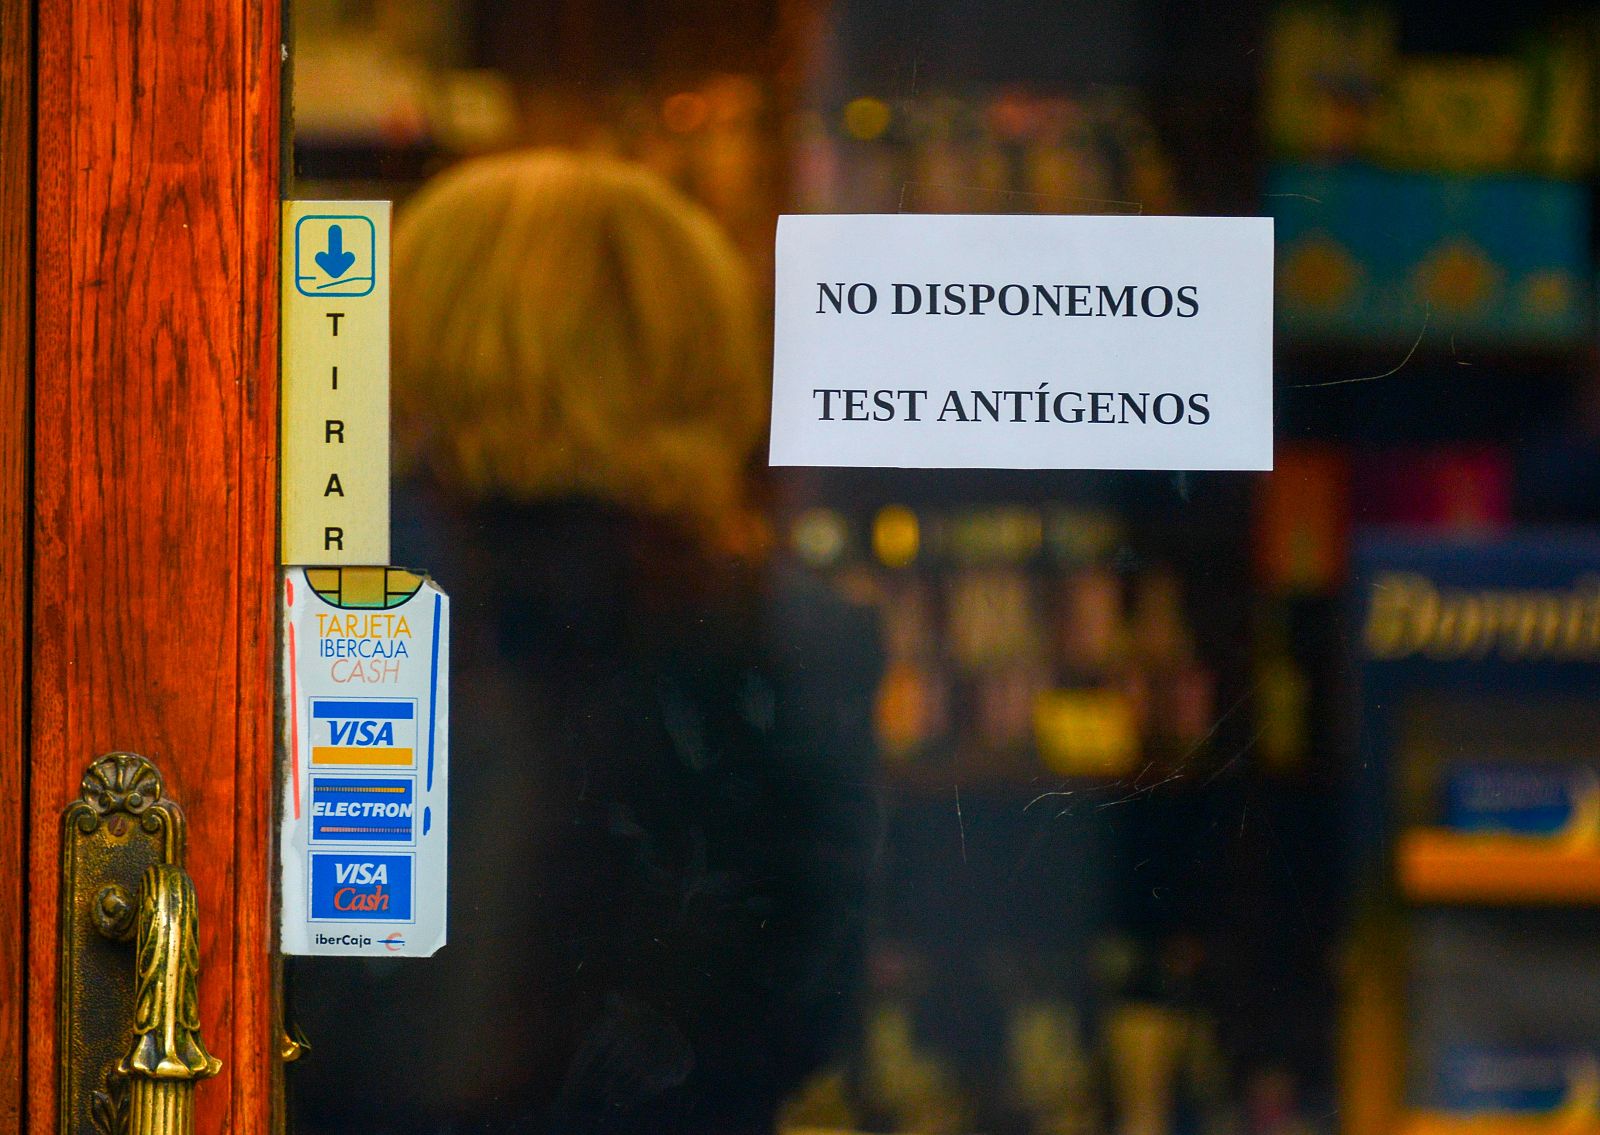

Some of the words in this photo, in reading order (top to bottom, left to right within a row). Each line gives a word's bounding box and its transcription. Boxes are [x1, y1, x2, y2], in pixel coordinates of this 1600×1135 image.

[815, 282, 878, 315] NO
[891, 283, 1200, 318] DISPONEMOS
[813, 388, 928, 422] TEST
[936, 382, 1211, 425] ANTÍGENOS
[323, 313, 345, 550] TIRAR
[315, 614, 412, 638] TARJETA
[320, 638, 409, 658] IBERCAJA
[331, 659, 400, 683] CASH
[327, 720, 394, 745] VISA
[312, 802, 414, 817] ELECTRON
[335, 863, 388, 884] VISA
[333, 885, 389, 911] Cash
[315, 934, 371, 948] iberCaja
